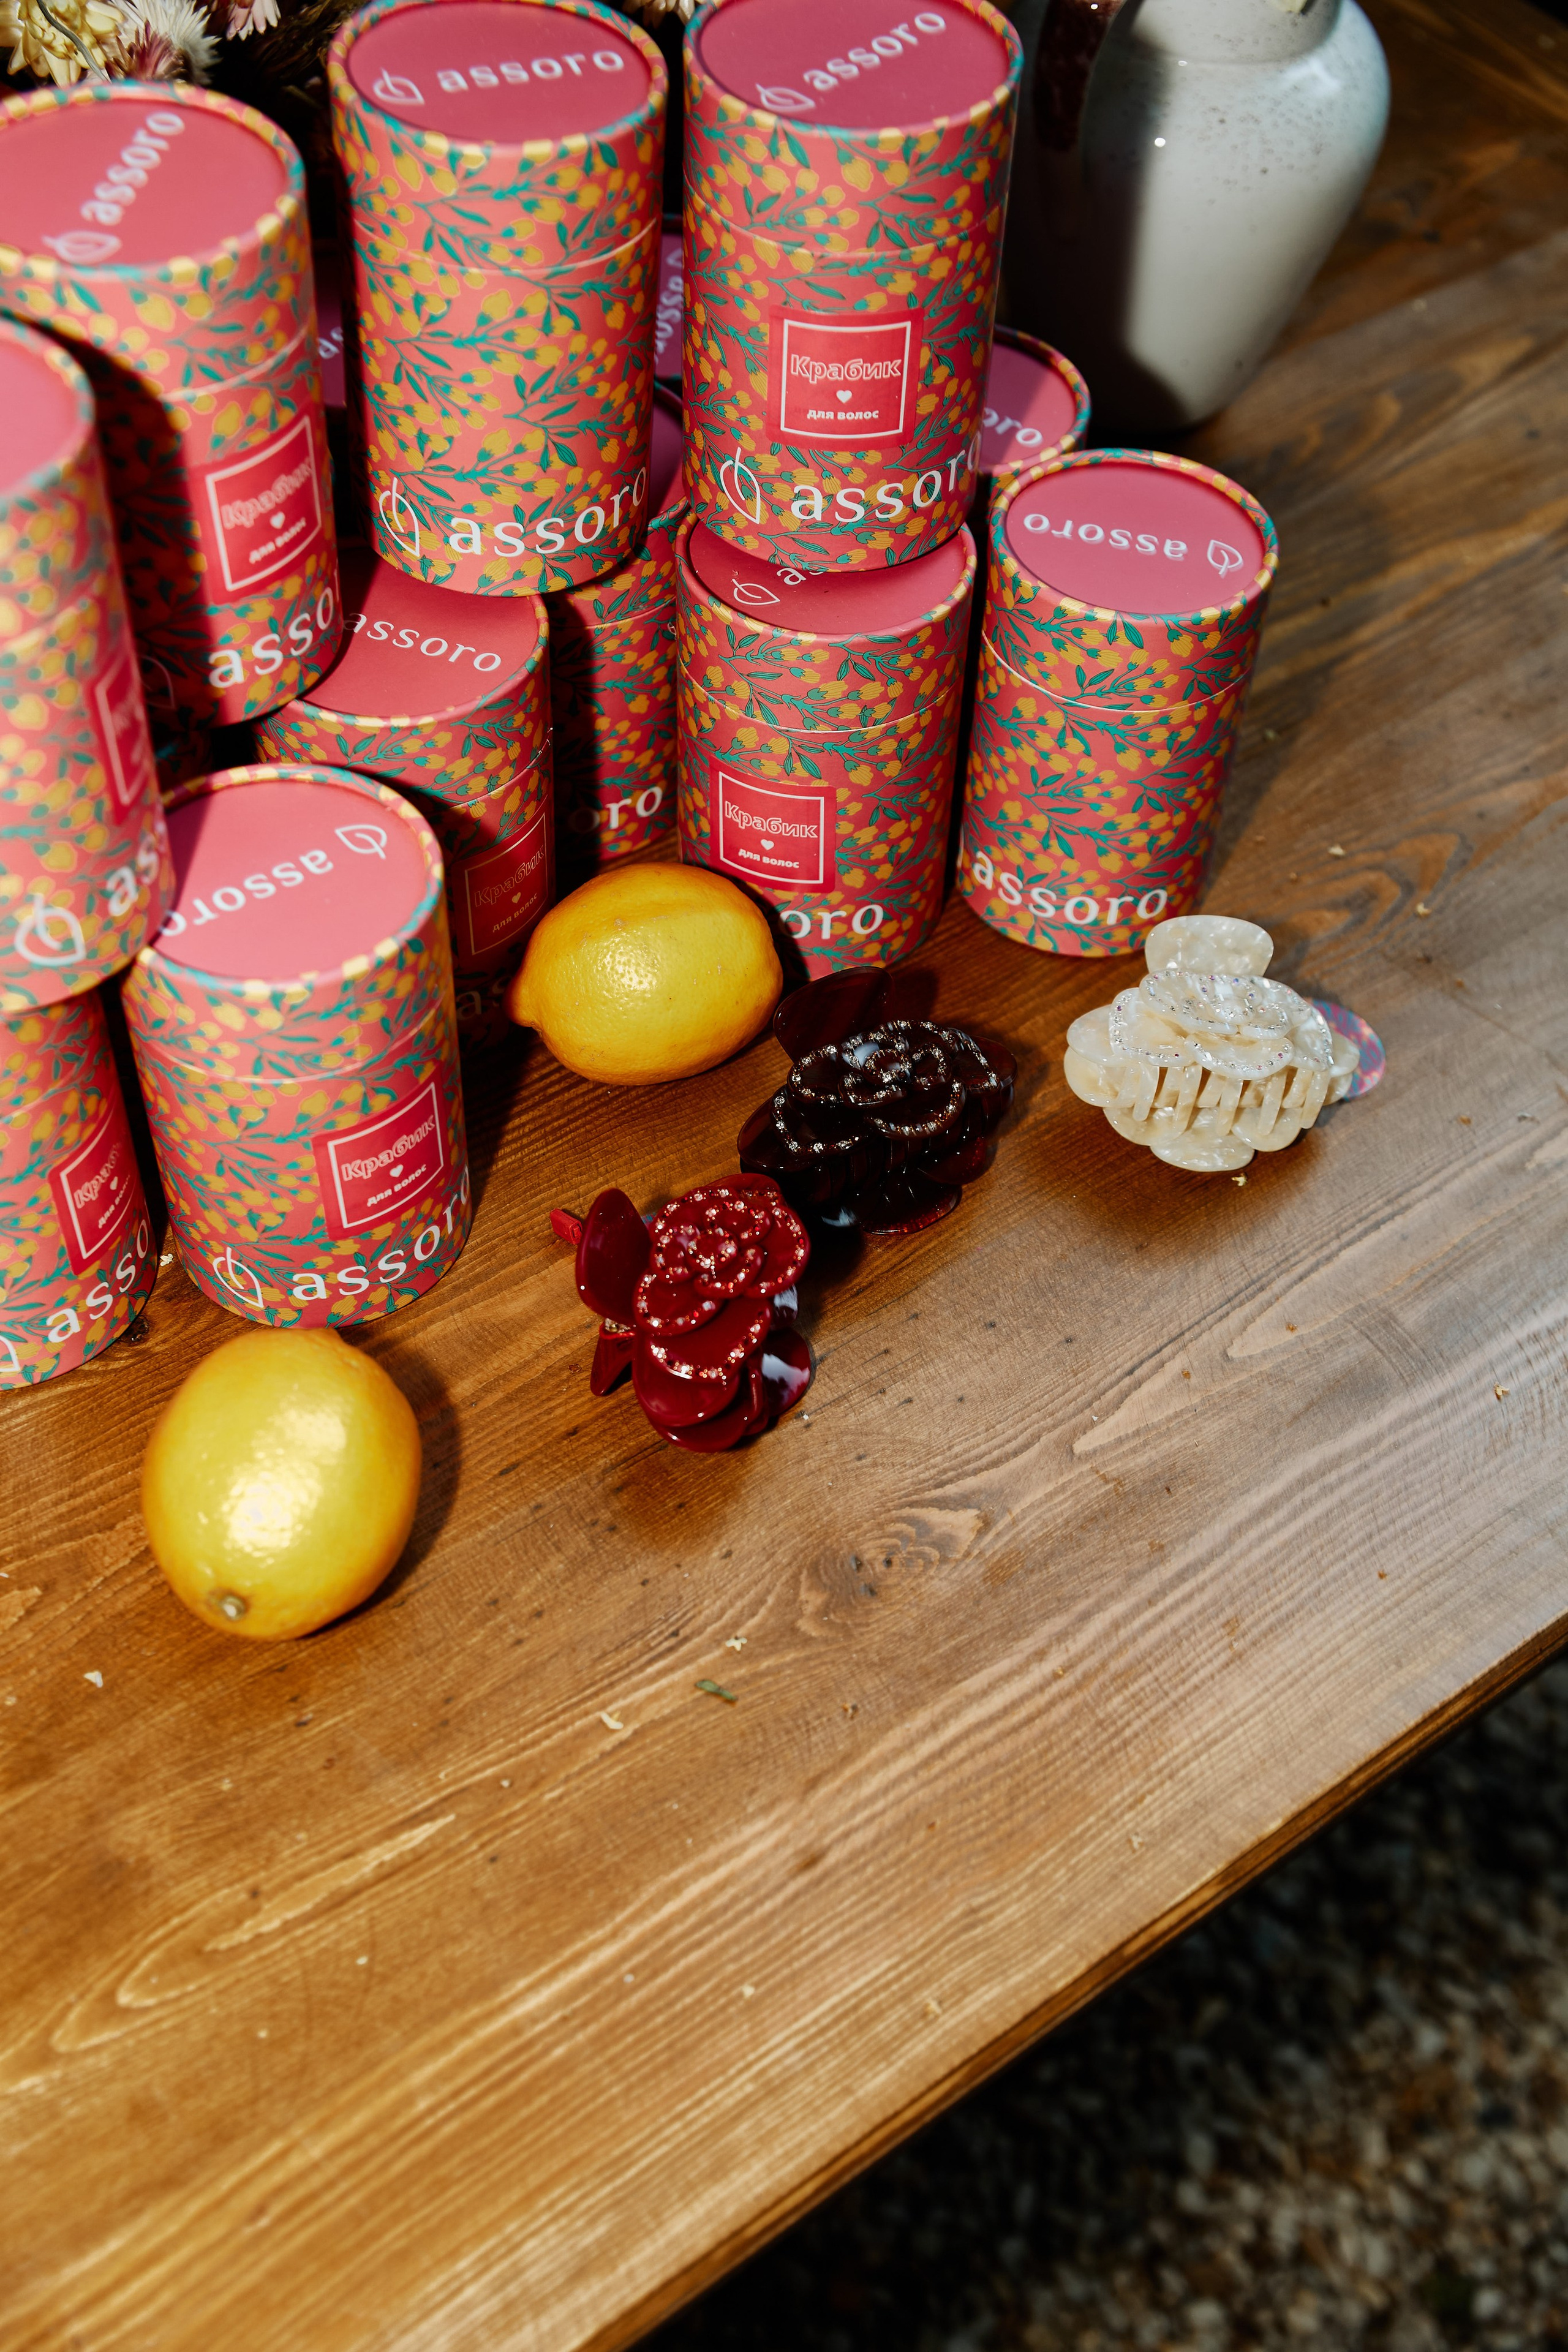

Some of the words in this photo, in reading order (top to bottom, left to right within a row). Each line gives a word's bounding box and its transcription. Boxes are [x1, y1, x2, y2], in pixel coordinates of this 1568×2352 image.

[437, 50, 624, 93] assoro
[804, 12, 946, 92] assoro
[80, 112, 185, 226] assoro
[791, 353, 902, 384] Крабик
[807, 409, 834, 421] для
[837, 410, 879, 420] волос
[449, 467, 647, 557] assoro
[1023, 513, 1188, 562] assoro
[344, 612, 502, 672] assoro
[725, 801, 818, 839] Крабик
[474, 845, 545, 908] Крабик
[738, 848, 761, 862] для
[762, 856, 800, 869] волос
[973, 851, 1168, 925] assoro
[492, 916, 512, 933] для
[514, 892, 537, 919] волос
[341, 1115, 435, 1182] Крабик
[367, 1188, 393, 1207] для
[393, 1164, 427, 1192] волос
[292, 1167, 469, 1300] assoro
[46, 1199, 151, 1343] asso
